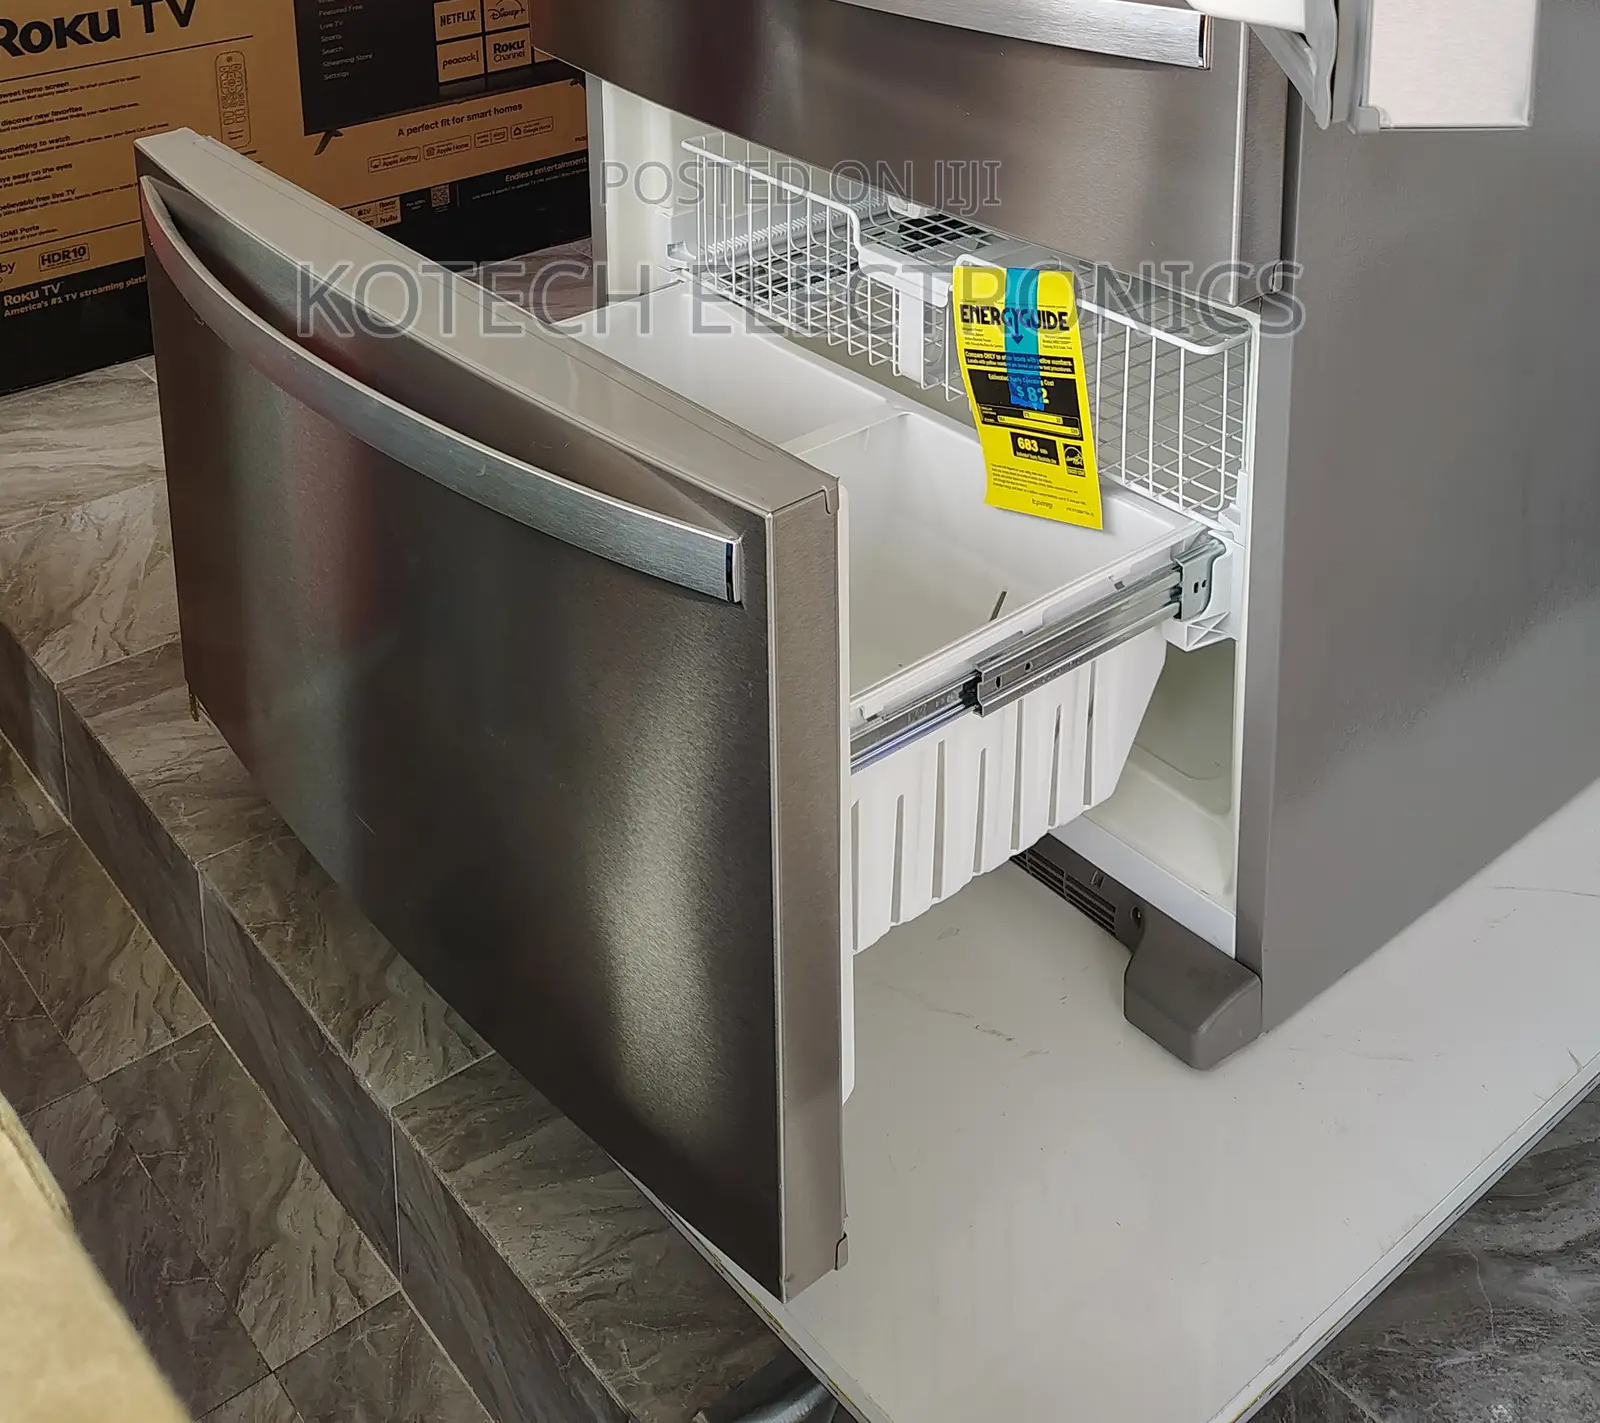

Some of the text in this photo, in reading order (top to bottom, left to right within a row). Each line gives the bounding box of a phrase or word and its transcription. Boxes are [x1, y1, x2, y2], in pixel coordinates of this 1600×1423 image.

[440, 9, 476, 27] NETFLIX
[322, 46, 344, 55] Search
[493, 39, 525, 54] Roku
[442, 52, 476, 69] peacock
[493, 50, 525, 63] Channel
[22, 85, 43, 94] home
[45, 81, 70, 89] screen
[1, 115, 33, 126] discover
[34, 112, 50, 120] new
[51, 106, 82, 117] favorites
[397, 102, 523, 137] A perfect fit for smart homes
[49, 135, 71, 145] watch
[56, 163, 73, 172] eyes
[505, 171, 533, 182] Endless
[535, 156, 587, 176] entertainment
[65, 188, 76, 196] TV
[41, 246, 87, 266] HDR10
[4, 282, 60, 306] Roku TV
[4, 299, 48, 317] America's
[51, 296, 63, 305] #1
[65, 292, 78, 301] TV
[80, 281, 124, 297] streaming
[1017, 436, 1039, 453] 683
